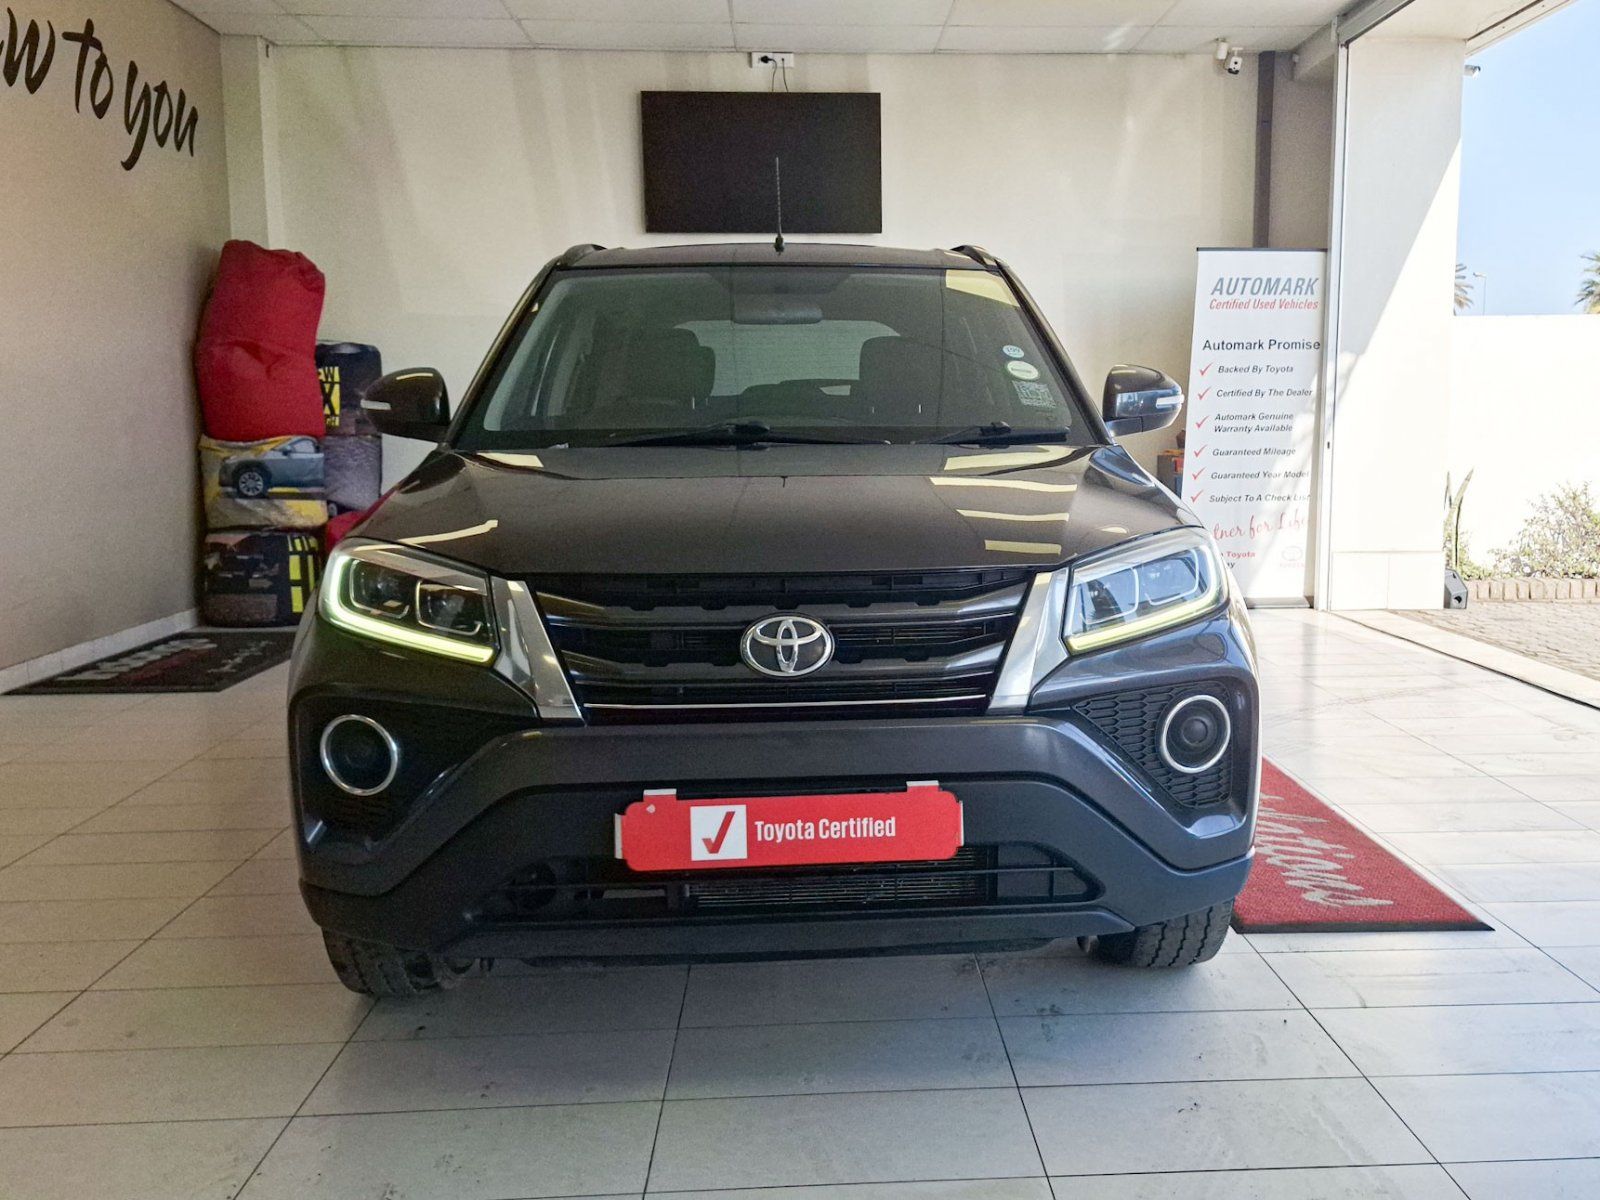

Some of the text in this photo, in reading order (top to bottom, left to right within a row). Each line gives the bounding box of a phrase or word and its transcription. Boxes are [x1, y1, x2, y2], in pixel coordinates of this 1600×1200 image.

[61, 18, 114, 119] to
[120, 60, 199, 171] you
[1211, 277, 1319, 296] AUTOMARK
[1209, 298, 1319, 310] Certified Used Vehicles
[1202, 338, 1321, 351] Automark Promise
[1217, 365, 1294, 375] Backed By Toyota
[1216, 388, 1313, 399] Certified By The Dealer
[1214, 412, 1294, 422] Automark Genuine
[1214, 424, 1293, 434] Warranty Available
[1212, 447, 1296, 457] Guaranteed Mileage
[1210, 471, 1260, 480] Guaranteed
[1262, 471, 1282, 479] Year
[1209, 494, 1242, 504] Subject
[1244, 494, 1255, 502] To
[1264, 494, 1291, 502] Check
[1226, 551, 1256, 560] Toyota
[754, 816, 897, 843] Toyota Certified
